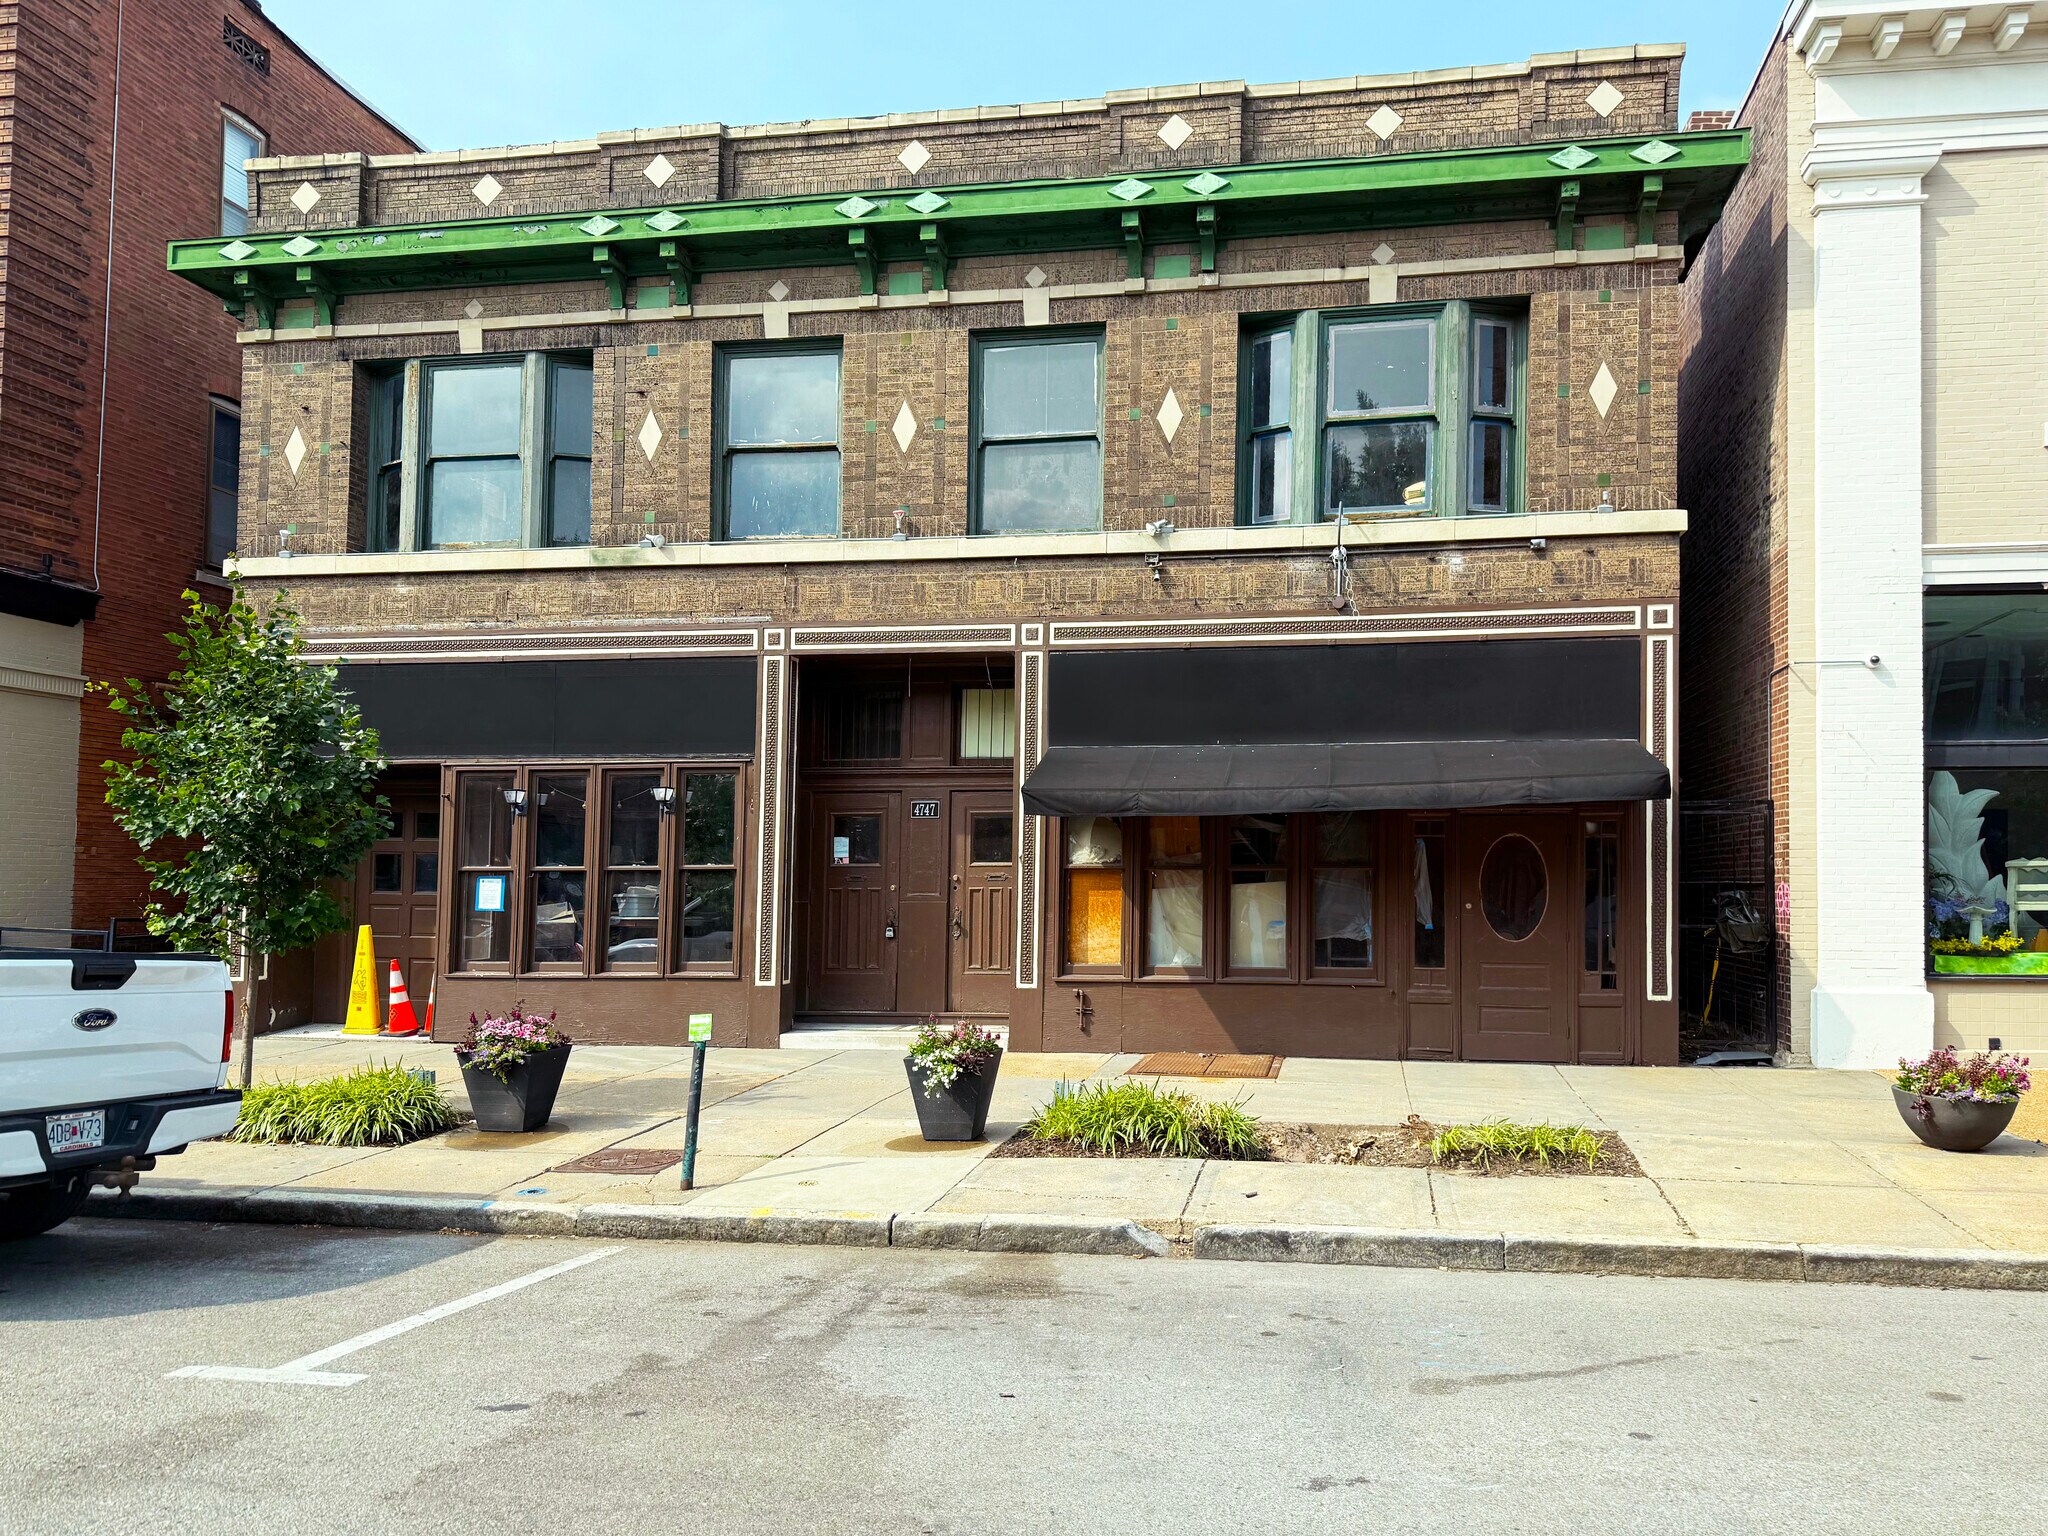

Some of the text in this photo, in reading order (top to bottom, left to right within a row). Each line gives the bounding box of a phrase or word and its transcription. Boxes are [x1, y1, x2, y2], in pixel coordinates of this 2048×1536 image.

[914, 804, 936, 816] 4747
[84, 1013, 109, 1027] Ford
[60, 1142, 94, 1151] CARDINALS
